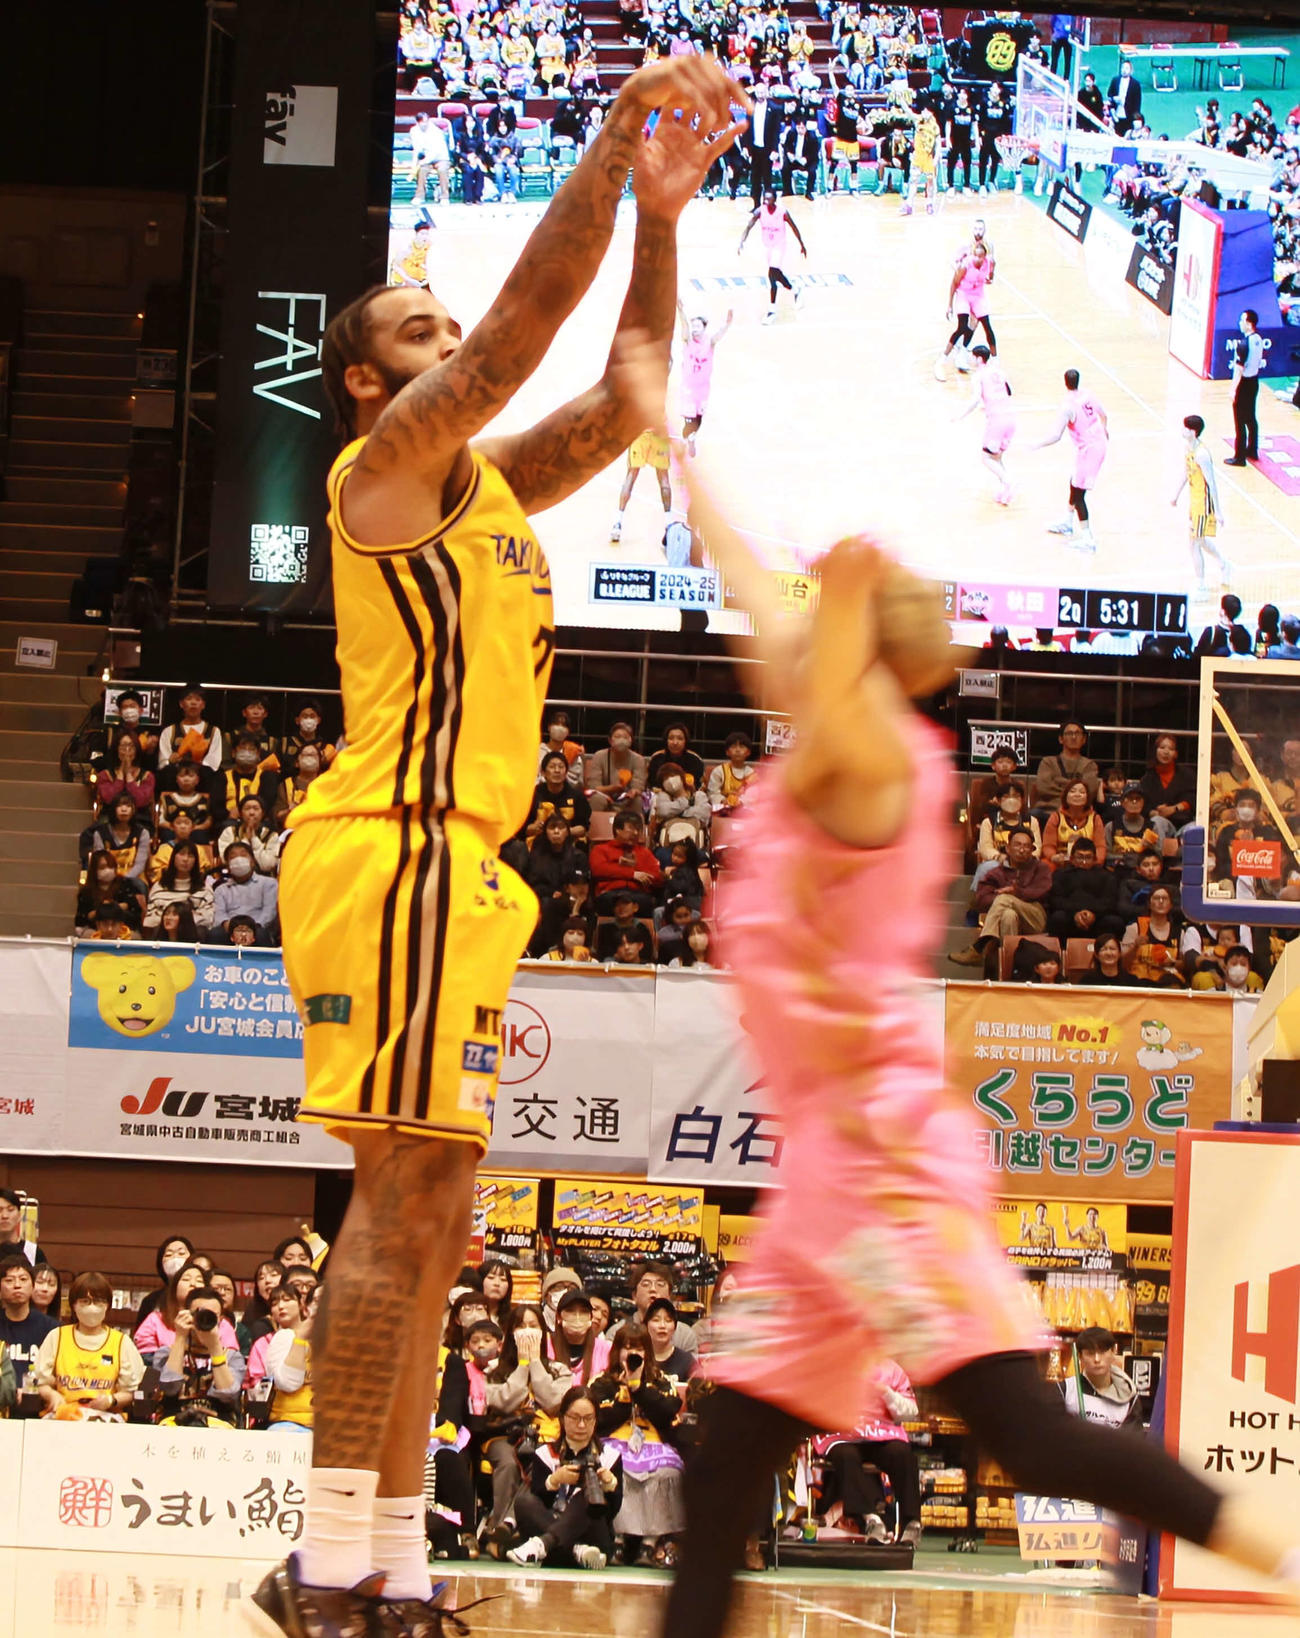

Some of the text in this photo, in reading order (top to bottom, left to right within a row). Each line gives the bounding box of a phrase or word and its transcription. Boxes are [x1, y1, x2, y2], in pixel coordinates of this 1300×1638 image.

[660, 574, 716, 590] 2024-25
[659, 589, 715, 603] SEASON
[1100, 598, 1139, 627] 5:31
[974, 1021, 1110, 1044] 満足度地域 No.1
[973, 1067, 1195, 1134] くらうど
[490, 1092, 620, 1144] 交通
[120, 1123, 301, 1145] 宮城県中古自動車販売商工組合
[1129, 1246, 1173, 1263] NINERS
[1229, 1411, 1280, 1431] HOT
[1204, 1444, 1300, 1476] ホット
[120, 1477, 306, 1543] うまい鮨
